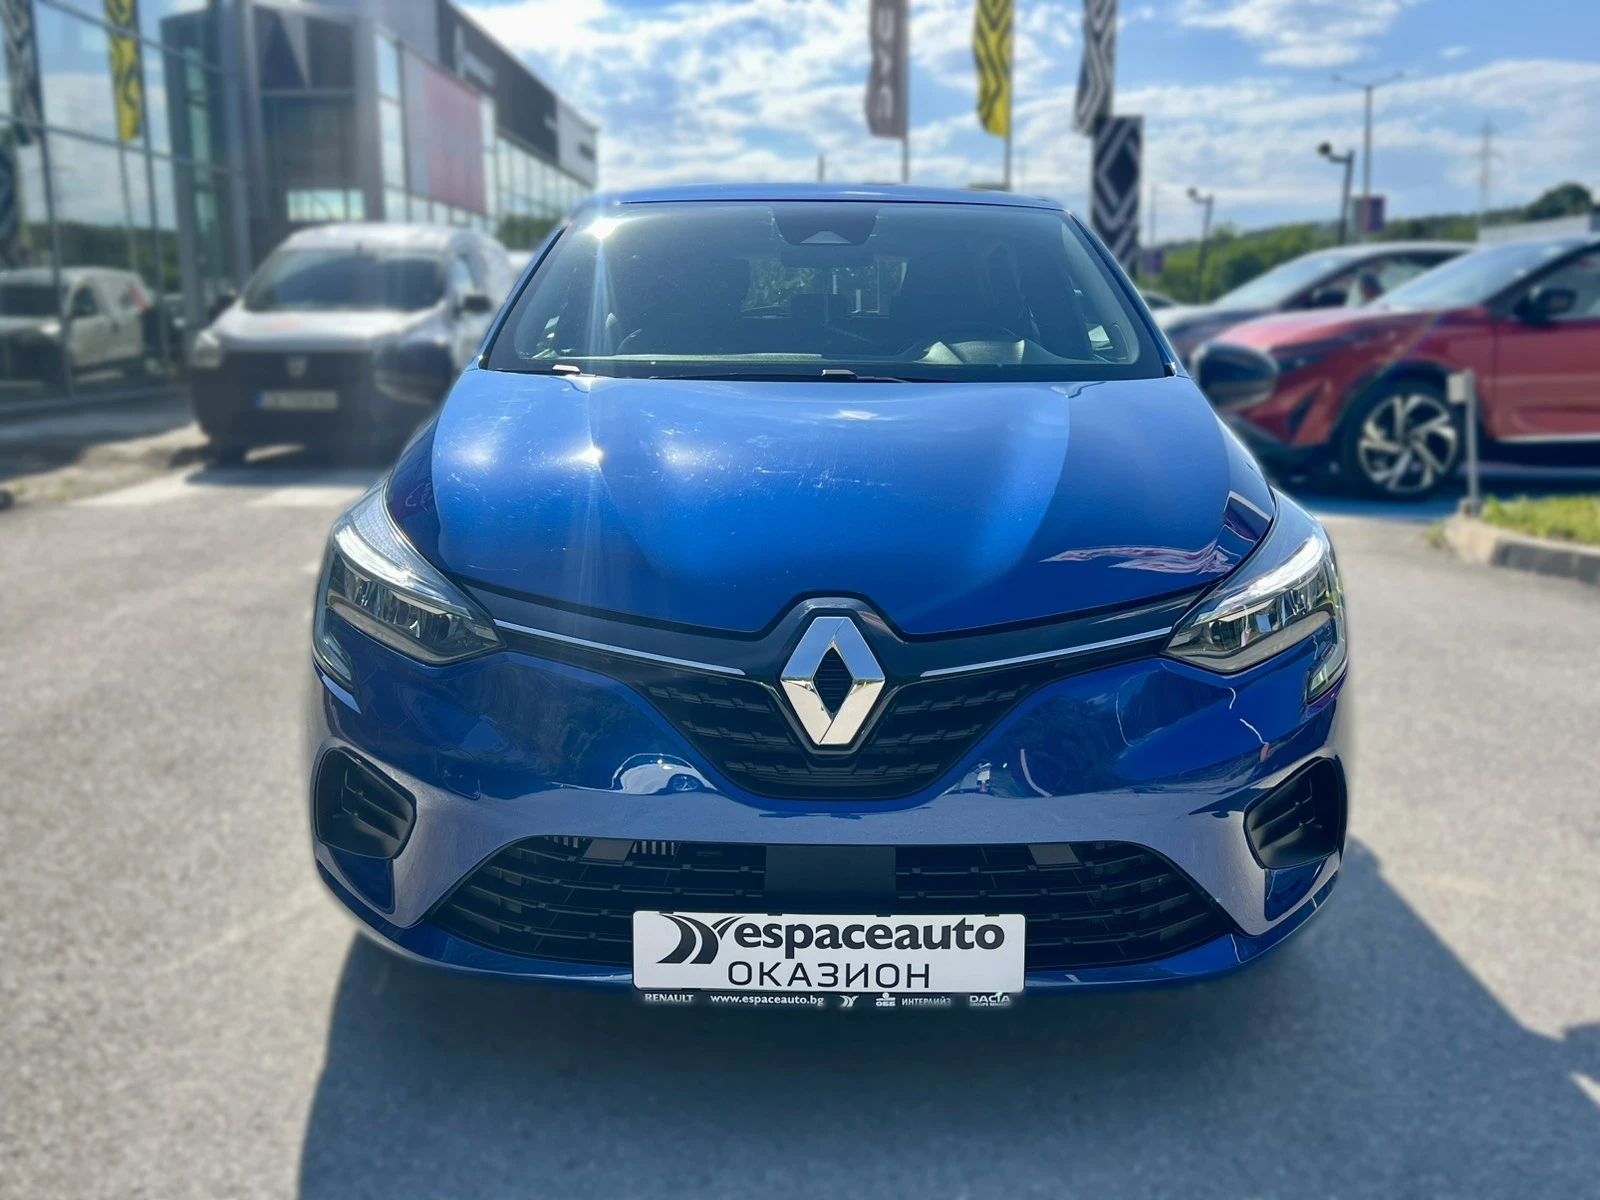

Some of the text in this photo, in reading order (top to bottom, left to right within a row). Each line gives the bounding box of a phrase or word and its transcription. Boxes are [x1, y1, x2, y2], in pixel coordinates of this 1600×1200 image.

[735, 917, 1005, 959] espaceauto
[728, 961, 930, 989] ОКАЗИОН
[645, 993, 694, 1003] RENAULT
[710, 995, 826, 1007] www.espaceauto.bg
[969, 994, 1010, 1003] DACIA
